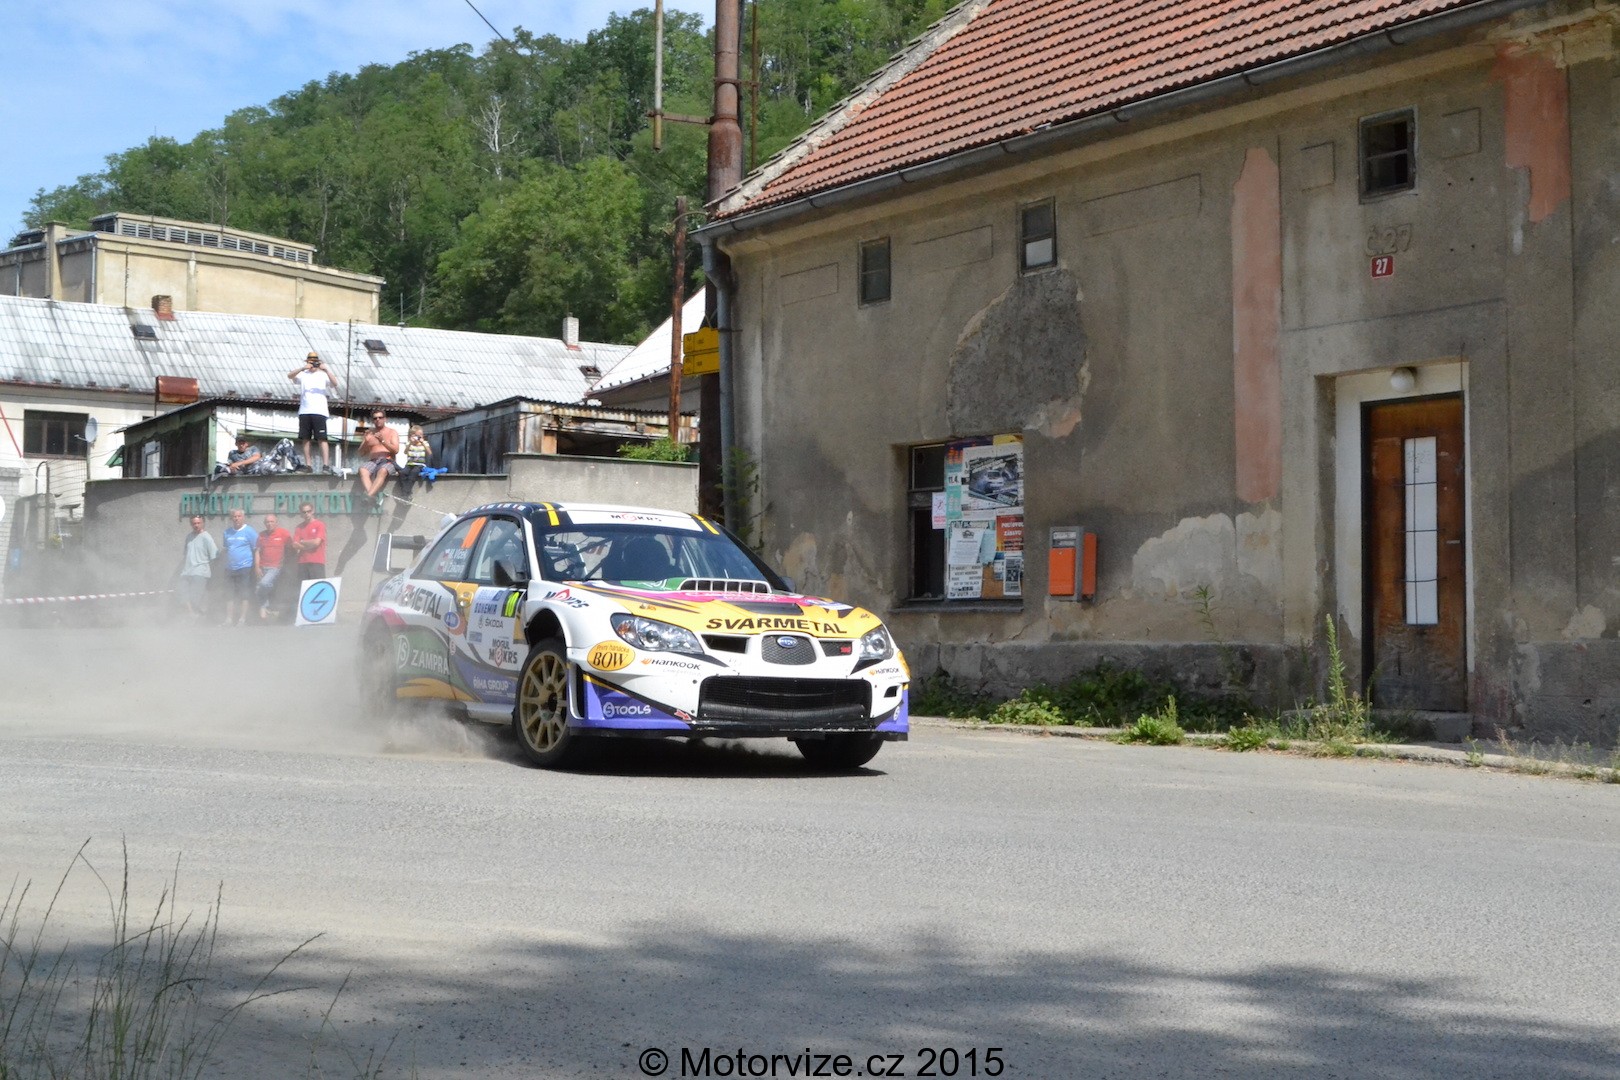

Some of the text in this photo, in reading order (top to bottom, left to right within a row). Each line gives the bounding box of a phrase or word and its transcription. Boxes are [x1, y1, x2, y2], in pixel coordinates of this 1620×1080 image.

[1376, 258, 1388, 275] 27
[182, 491, 256, 514] PIVOVAR
[485, 617, 504, 629] ŠKODA
[706, 617, 848, 635] SVARMETAL
[592, 651, 628, 669] BOW
